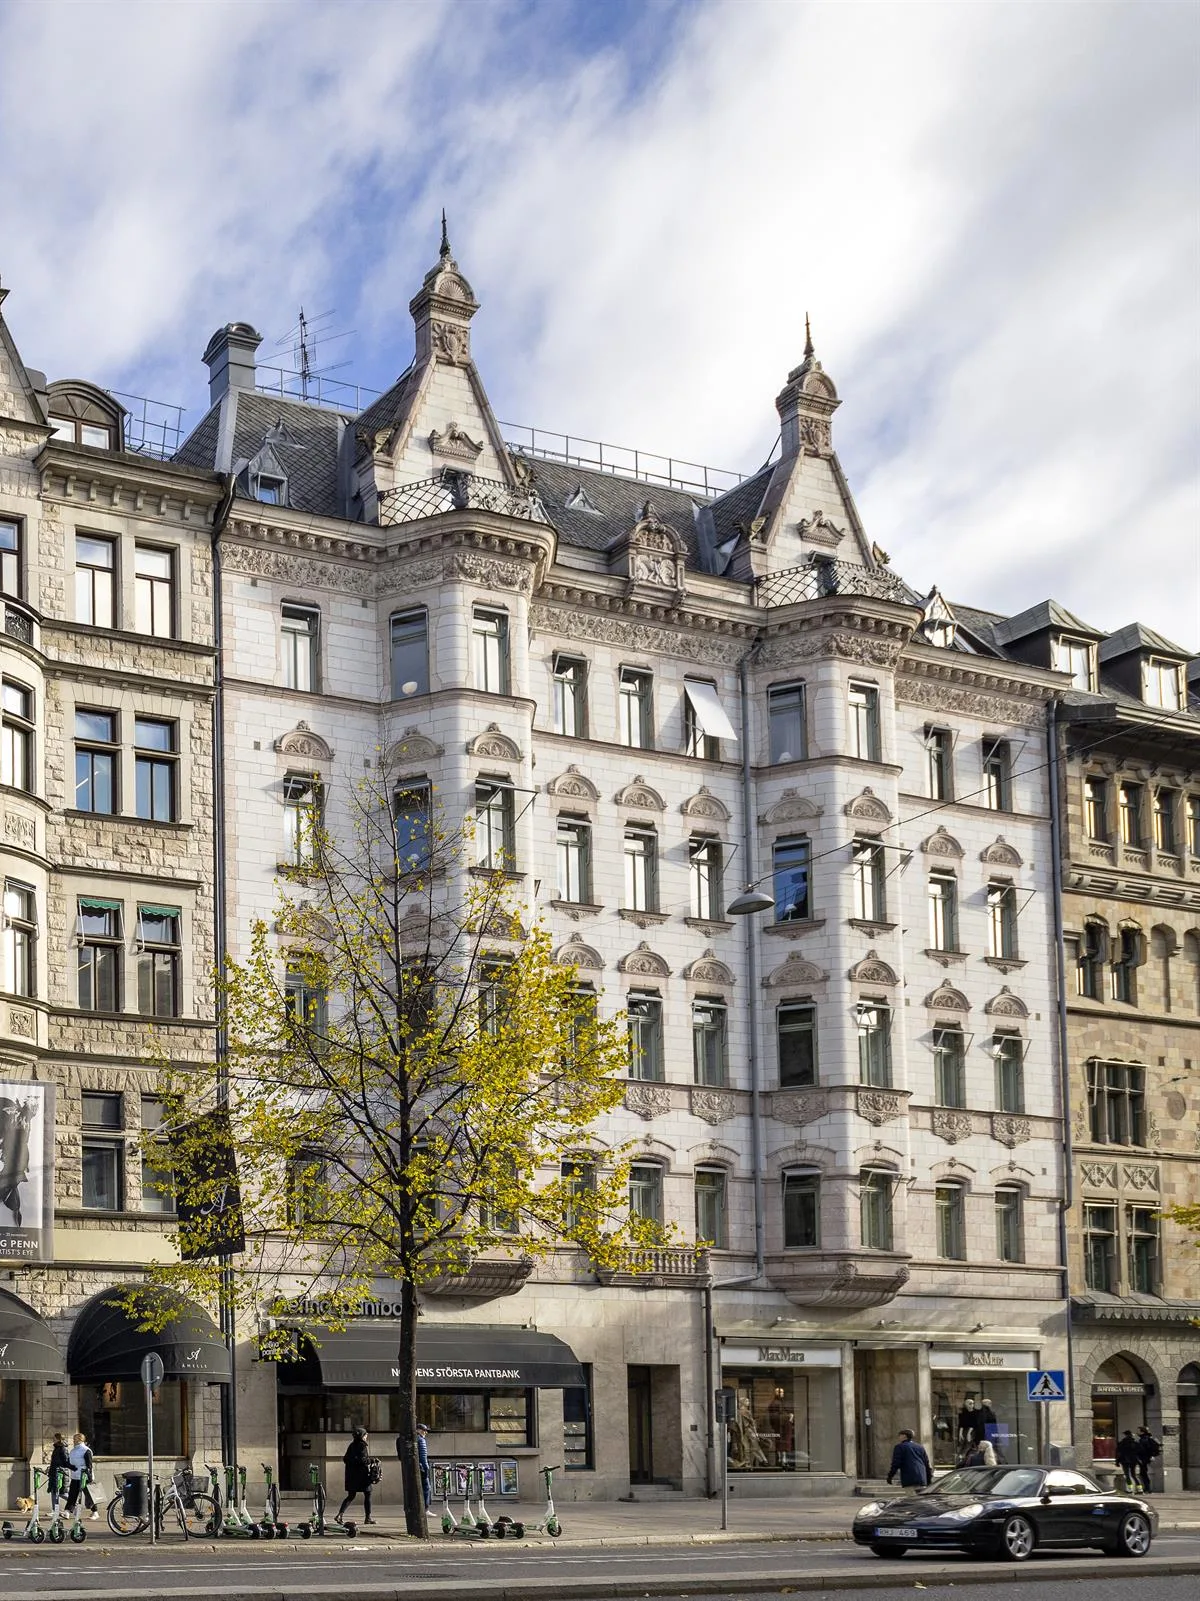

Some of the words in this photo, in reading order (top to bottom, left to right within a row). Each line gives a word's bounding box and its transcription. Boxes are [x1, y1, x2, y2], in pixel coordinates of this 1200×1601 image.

[10, 1239, 39, 1249] PENN
[757, 1345, 805, 1362] MaxMara
[391, 1367, 435, 1378] NENS
[436, 1366, 474, 1378] STÖRSTA
[474, 1368, 521, 1380] PANTBANK
